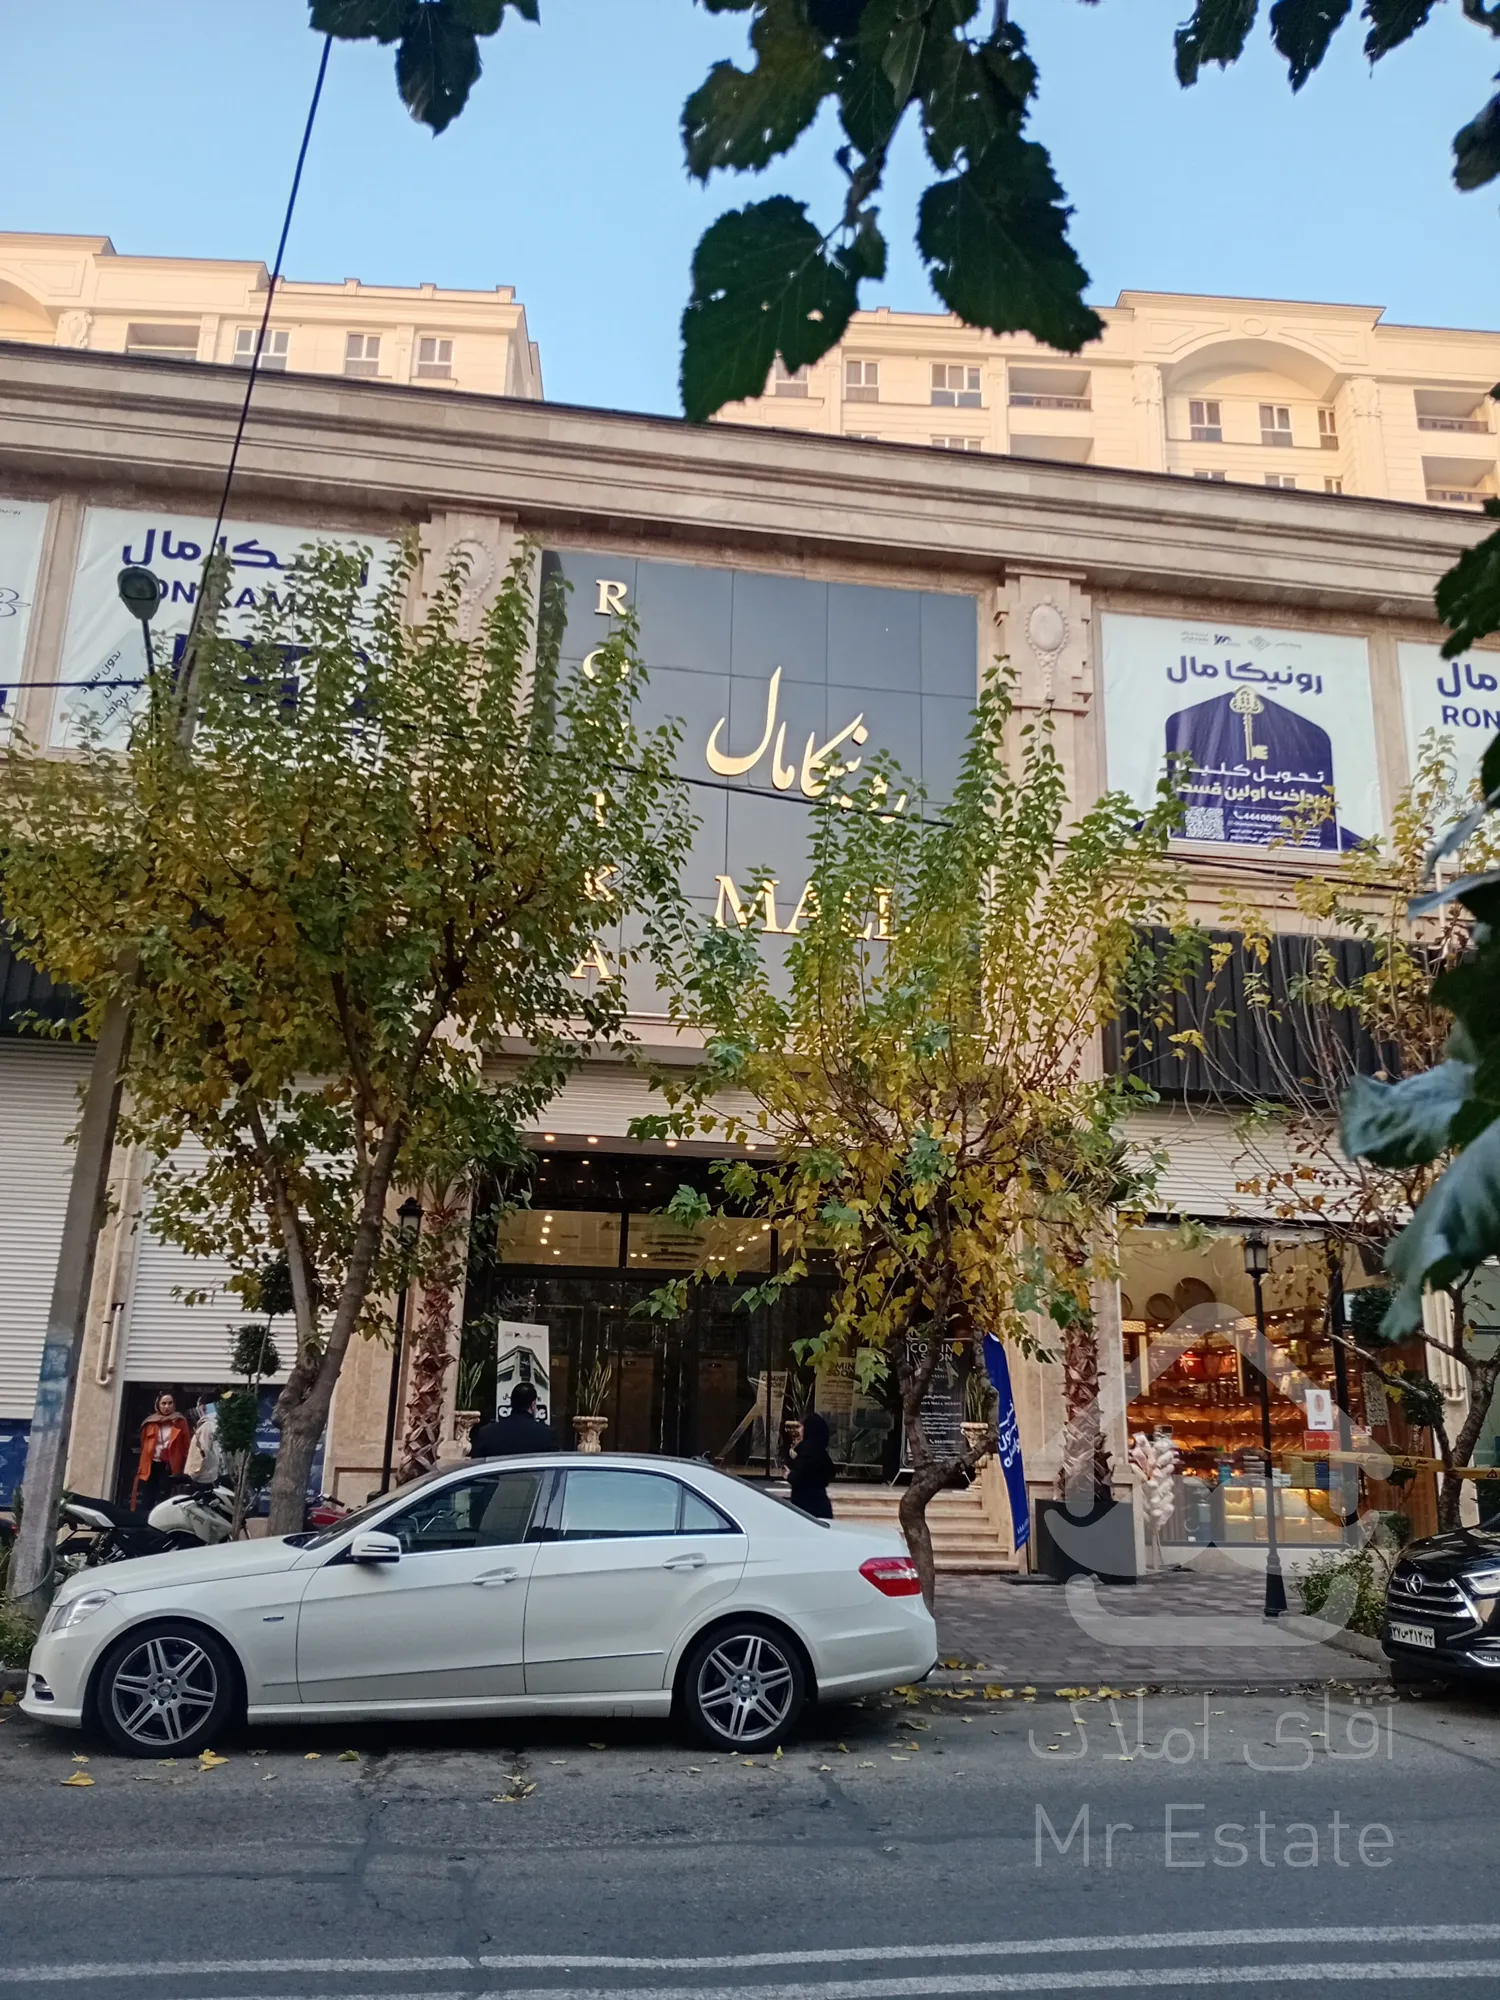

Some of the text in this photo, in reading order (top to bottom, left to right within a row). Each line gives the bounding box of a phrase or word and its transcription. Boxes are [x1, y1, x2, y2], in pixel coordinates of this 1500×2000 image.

[122, 528, 201, 566] مال
[80, 672, 101, 694] سد
[1166, 655, 1323, 695] رونیکا مال
[1437, 662, 1498, 698] مال
[103, 673, 123, 698] بدن
[570, 579, 630, 980] ROIKA
[1187, 762, 1250, 778] کلی
[1252, 765, 1325, 783] تحویل
[1224, 785, 1266, 802] اولین
[1267, 789, 1332, 804] داخت
[910, 1342, 964, 1354] COIN
[920, 1353, 953, 1362] SON
